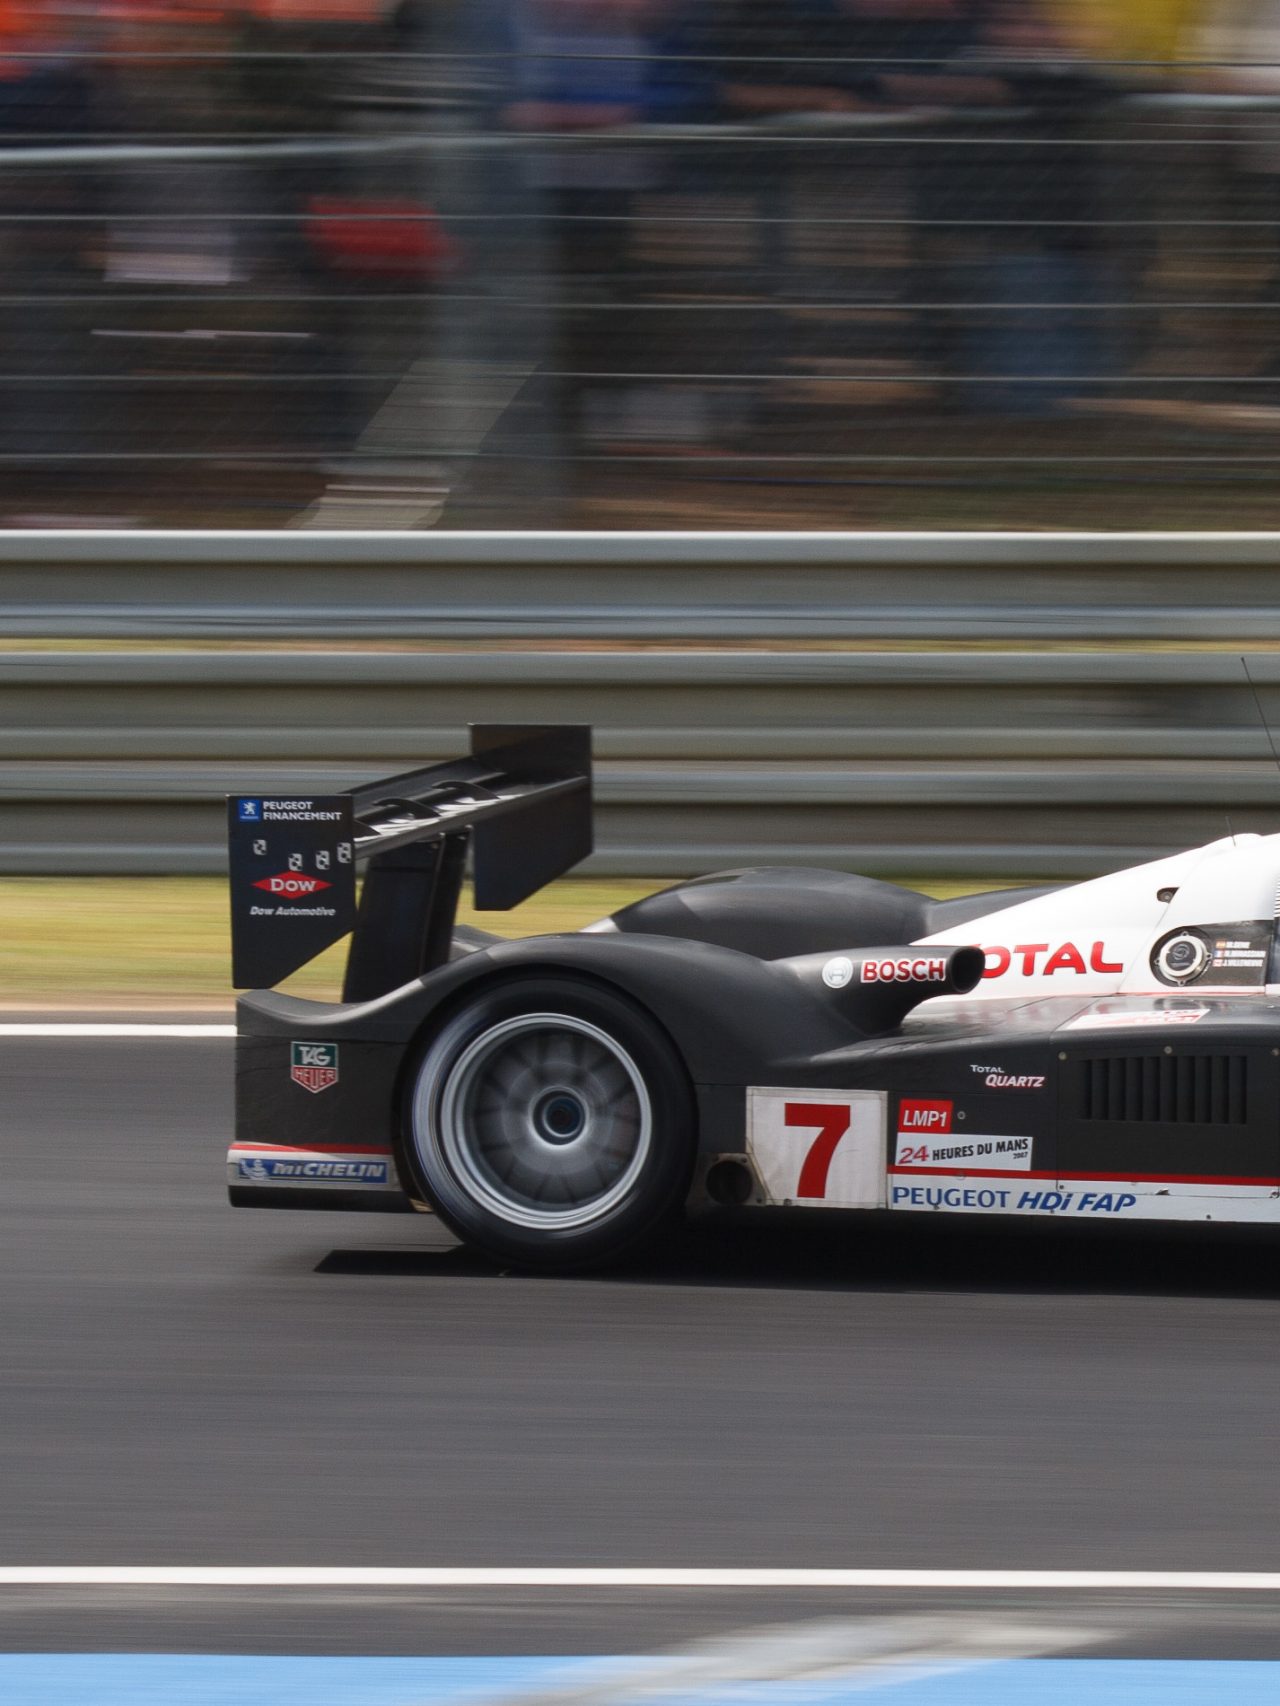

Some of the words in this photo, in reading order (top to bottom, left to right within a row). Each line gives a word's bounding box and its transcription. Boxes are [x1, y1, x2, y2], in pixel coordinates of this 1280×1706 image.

[262, 801, 313, 810] PEUGEOT
[262, 812, 343, 820] FINANCEMENT
[249, 906, 274, 915] Dow
[275, 906, 336, 916] Automotive
[861, 958, 946, 983] BOSCH
[970, 941, 1124, 979] OTAL
[299, 1046, 331, 1066] TAG
[293, 1068, 337, 1090] HEUER
[903, 1110, 947, 1127] LMP1
[784, 1102, 851, 1199] 7
[898, 1145, 929, 1164] 24
[932, 1145, 974, 1161] HEURES
[977, 1142, 993, 1156] DU
[995, 1138, 1029, 1153] MANS
[893, 1186, 1010, 1208] PEUGEOT
[1016, 1191, 1073, 1210] HDi
[1077, 1193, 1137, 1212] FAP
